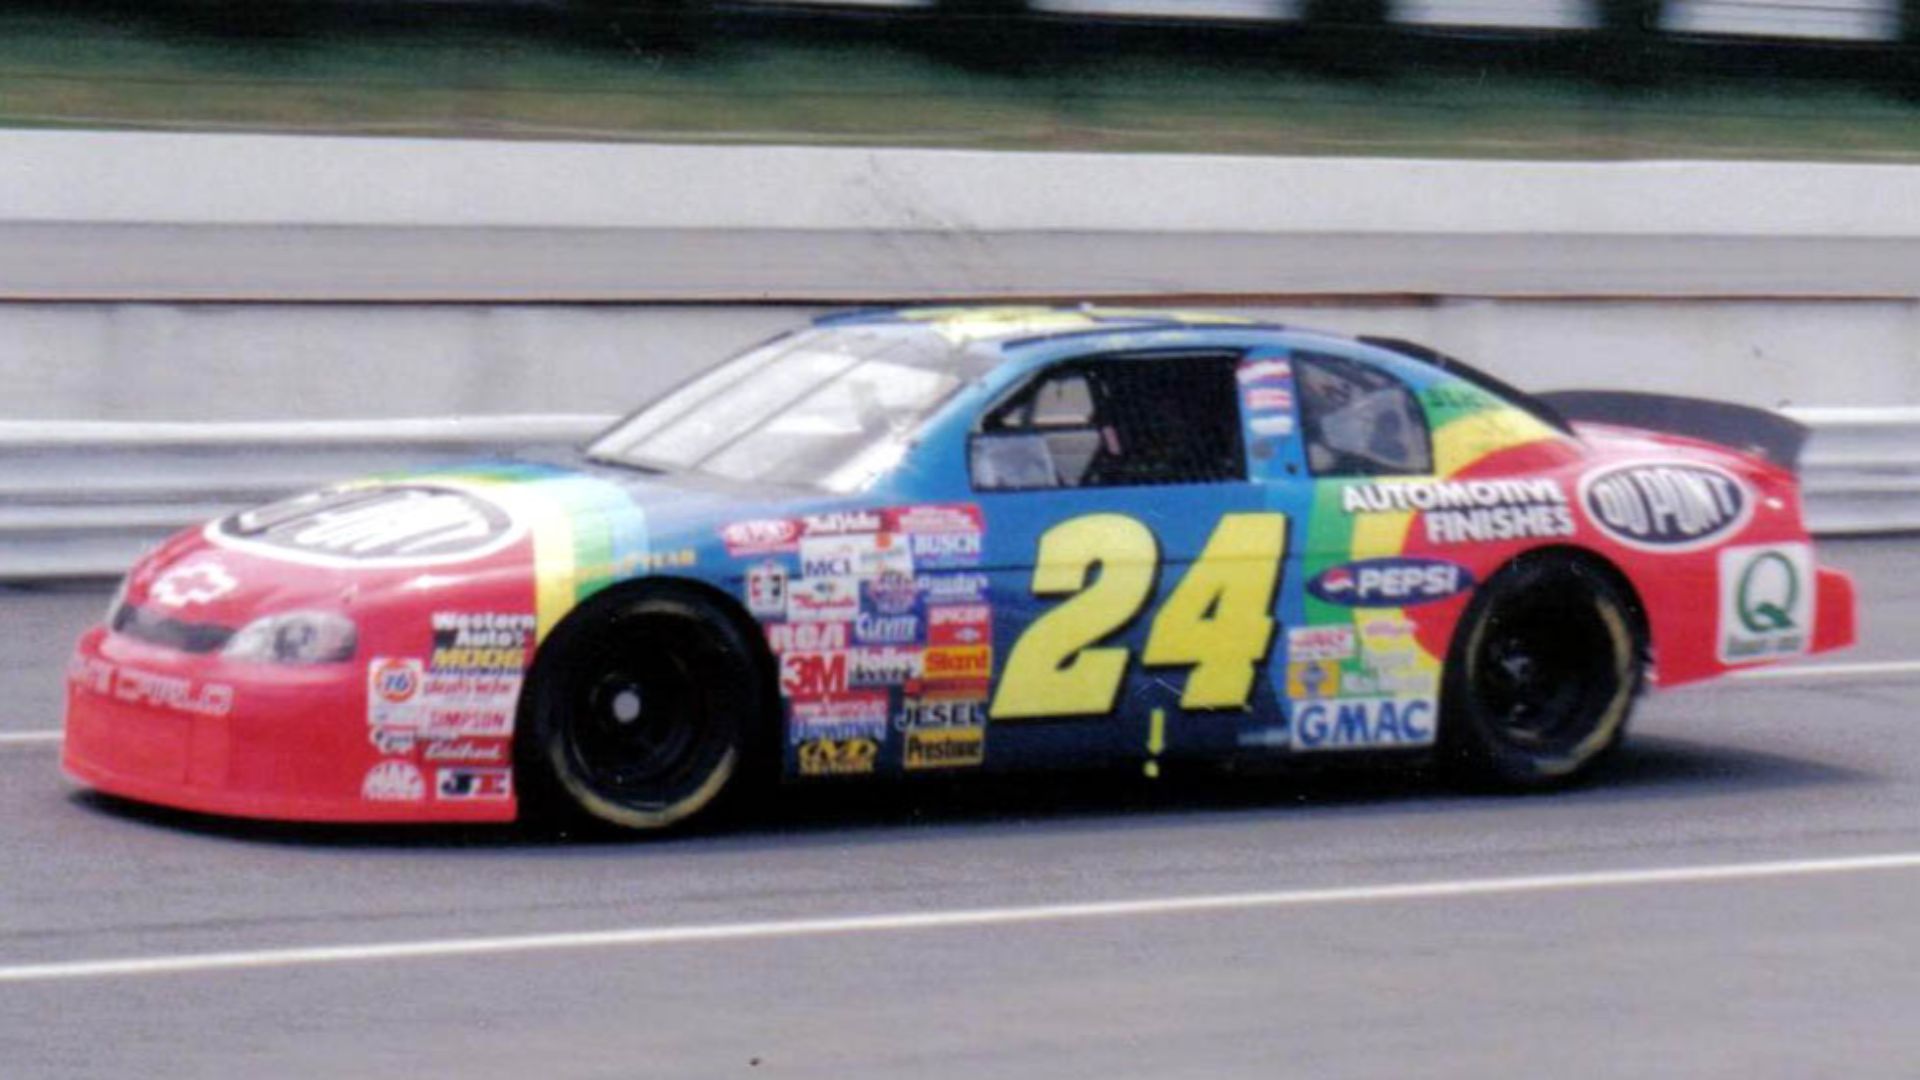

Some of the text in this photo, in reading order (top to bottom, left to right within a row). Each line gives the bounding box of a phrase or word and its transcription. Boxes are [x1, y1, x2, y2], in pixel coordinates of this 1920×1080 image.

[1342, 480, 1567, 513] AUTOMOTIVE
[1423, 504, 1576, 544] FINISHES
[804, 558, 853, 577] MCI
[1357, 565, 1459, 598] PEPSI
[1736, 550, 1800, 634] Q
[431, 612, 537, 632] Western
[989, 511, 1288, 719] 24
[782, 653, 847, 697] 3M
[429, 710, 507, 729] SIMPSON
[895, 700, 986, 731] JESEL
[1297, 700, 1431, 748] GMAC
